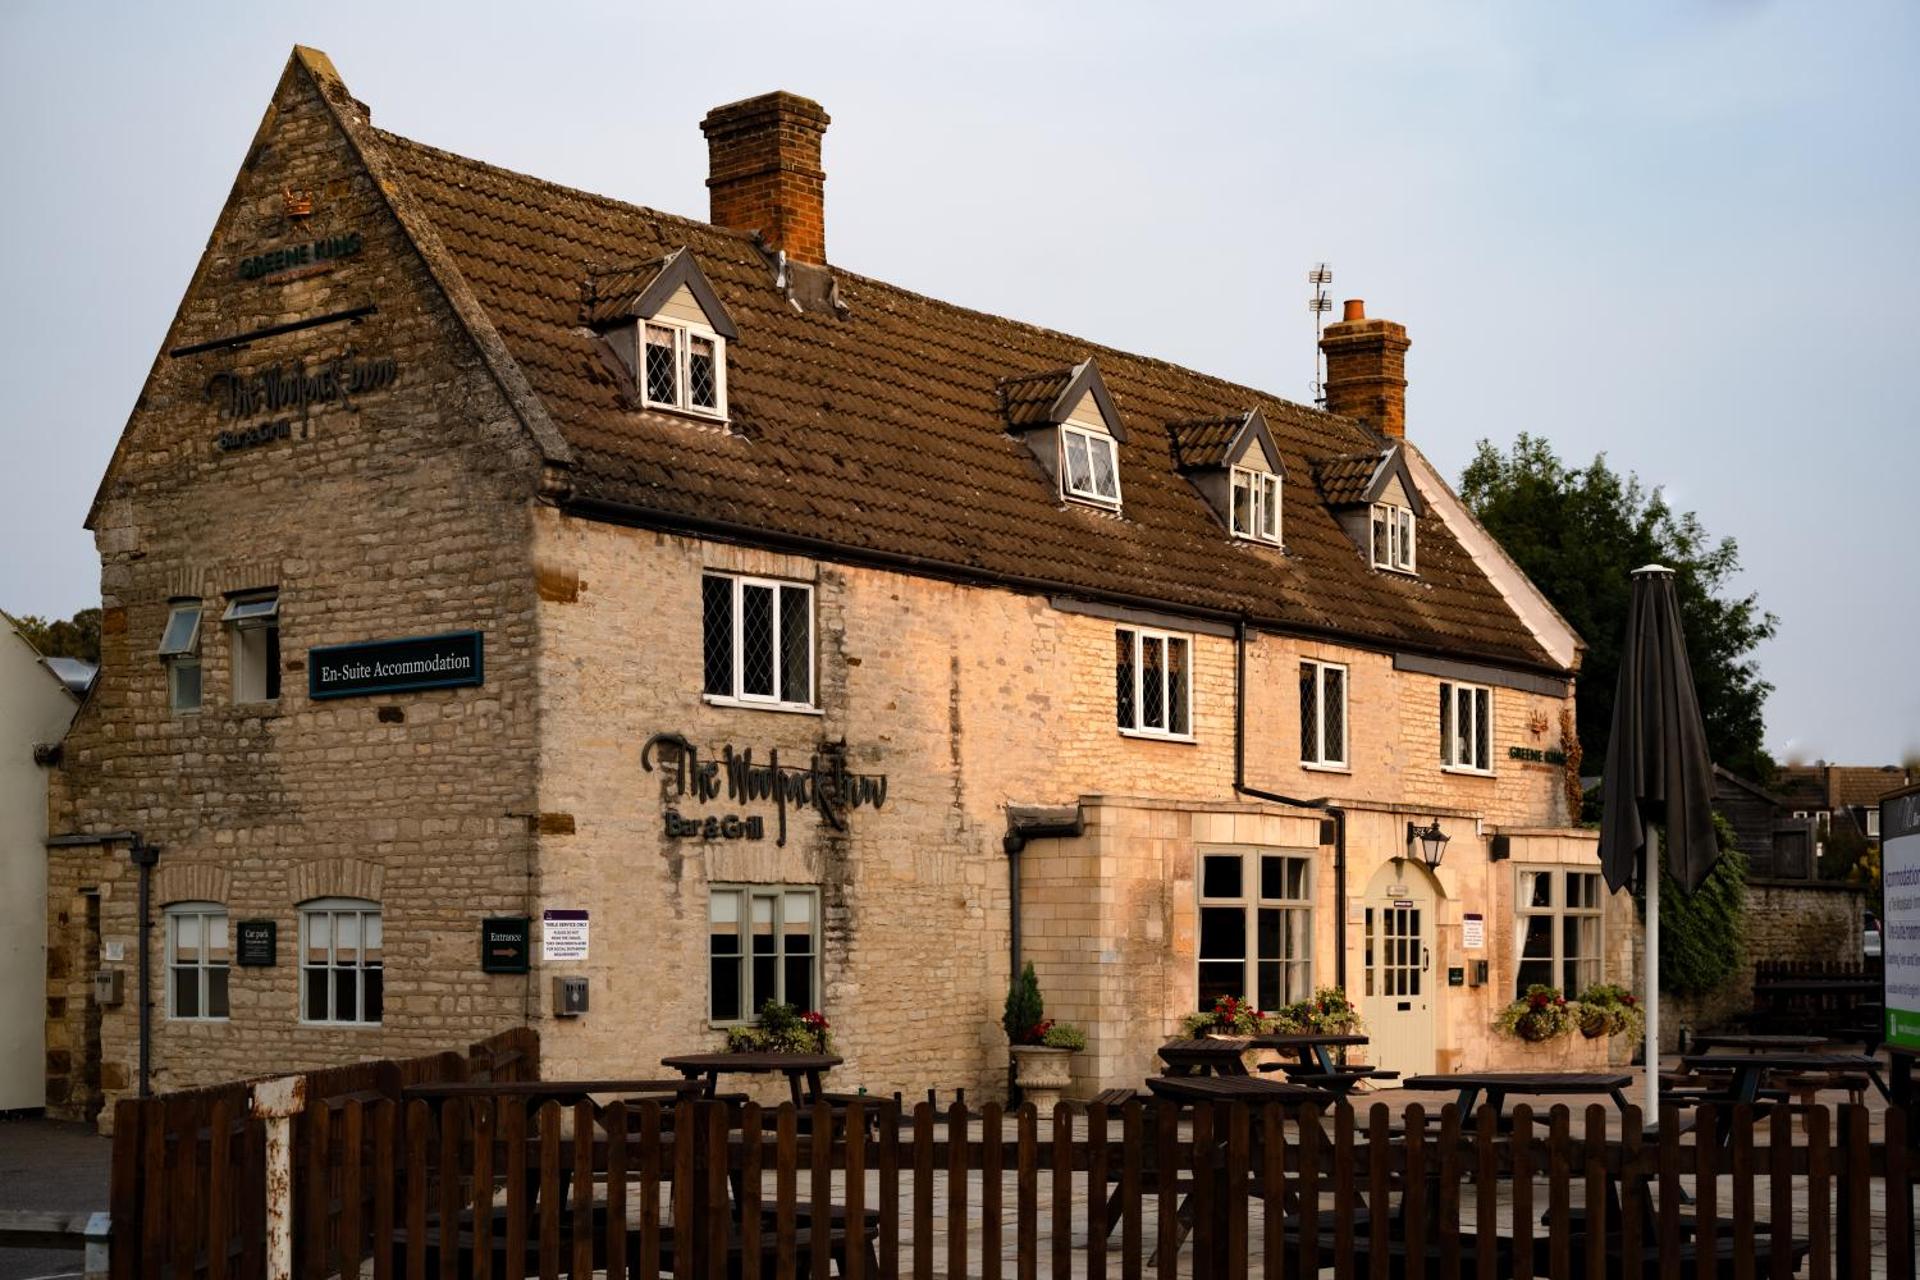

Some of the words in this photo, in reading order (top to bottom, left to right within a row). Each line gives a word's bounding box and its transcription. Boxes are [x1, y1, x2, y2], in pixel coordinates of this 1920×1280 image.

[321, 662, 371, 682] En-Suite
[373, 652, 471, 677] Accommodation
[1508, 746, 1543, 763] GREENE
[641, 733, 722, 804] The
[723, 743, 845, 848] Woolpack
[665, 810, 701, 838] Bar
[702, 814, 720, 840] &
[721, 813, 764, 840] Grill
[490, 932, 522, 942] Entrance
